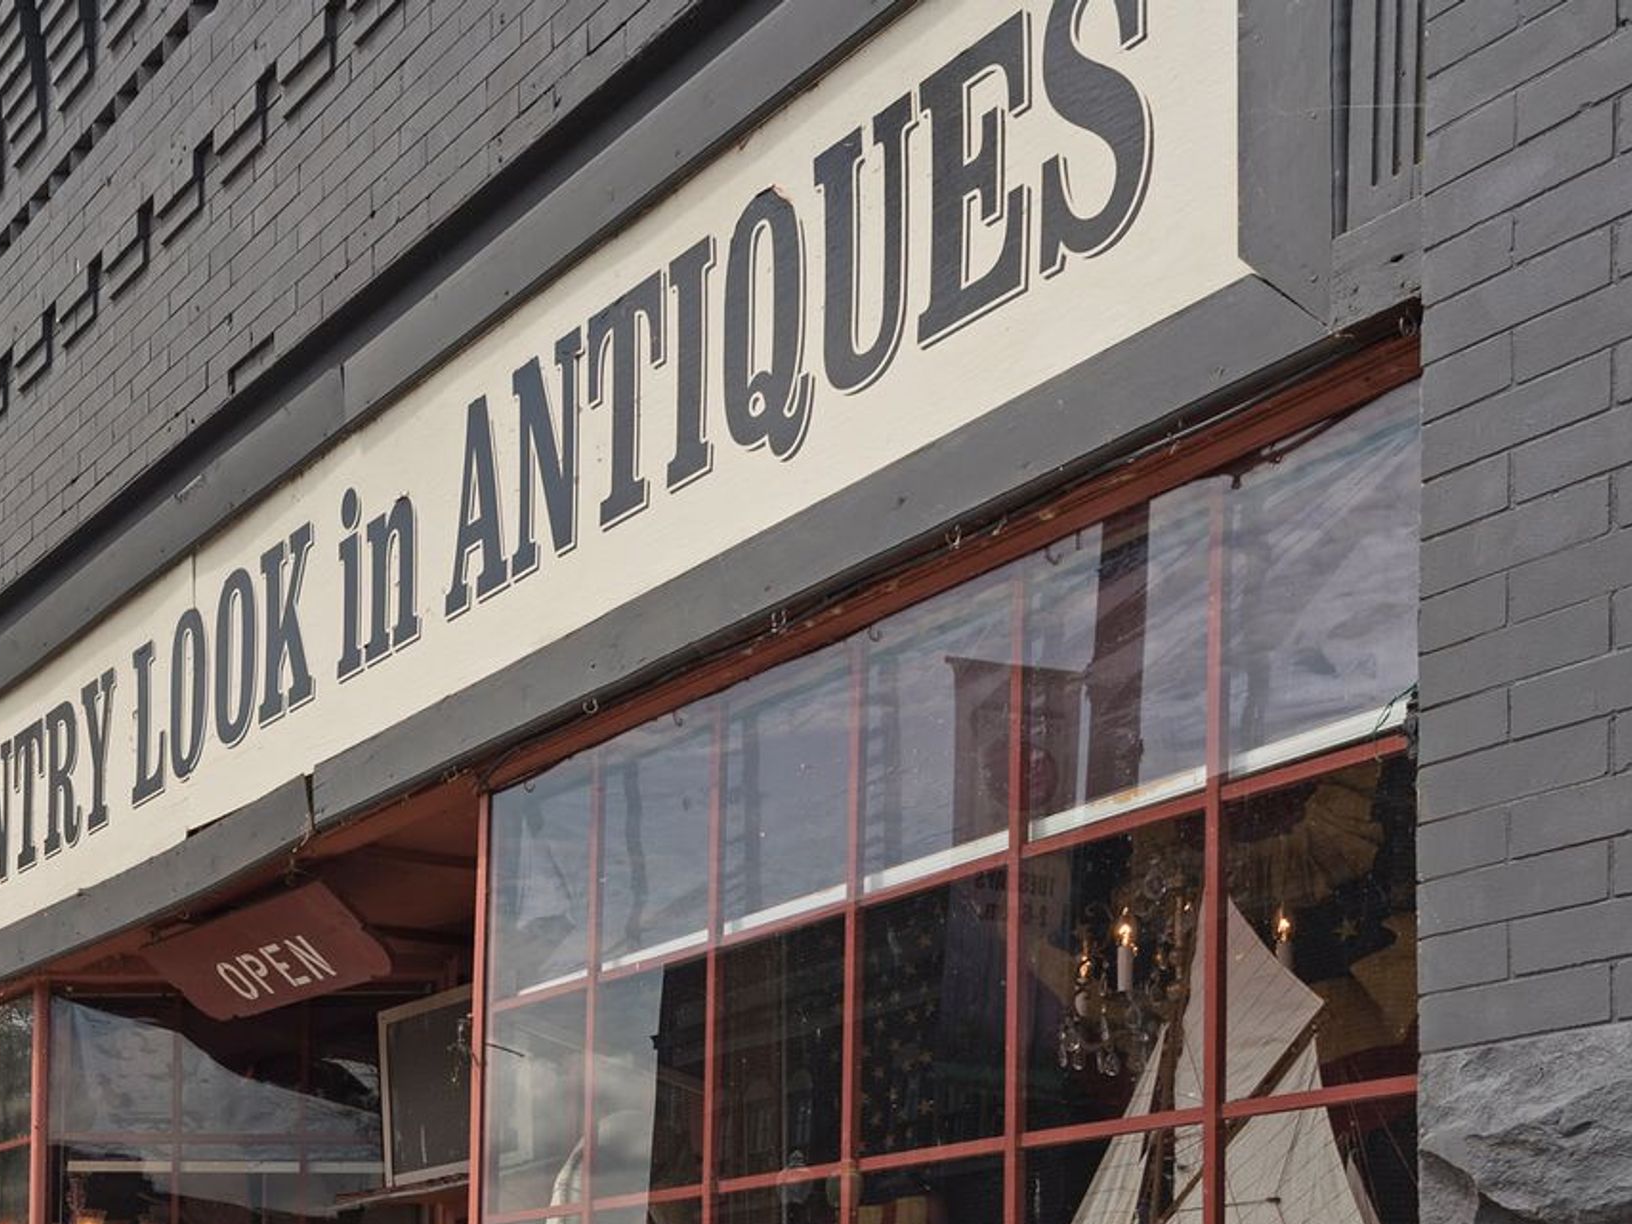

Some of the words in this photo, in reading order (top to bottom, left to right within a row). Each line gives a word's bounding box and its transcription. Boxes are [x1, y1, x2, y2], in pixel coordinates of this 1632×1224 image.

[132, 523, 317, 809] LOOK
[337, 487, 422, 683] in
[444, 0, 1154, 619] ANTIQUES
[216, 935, 338, 1000] OPEN
